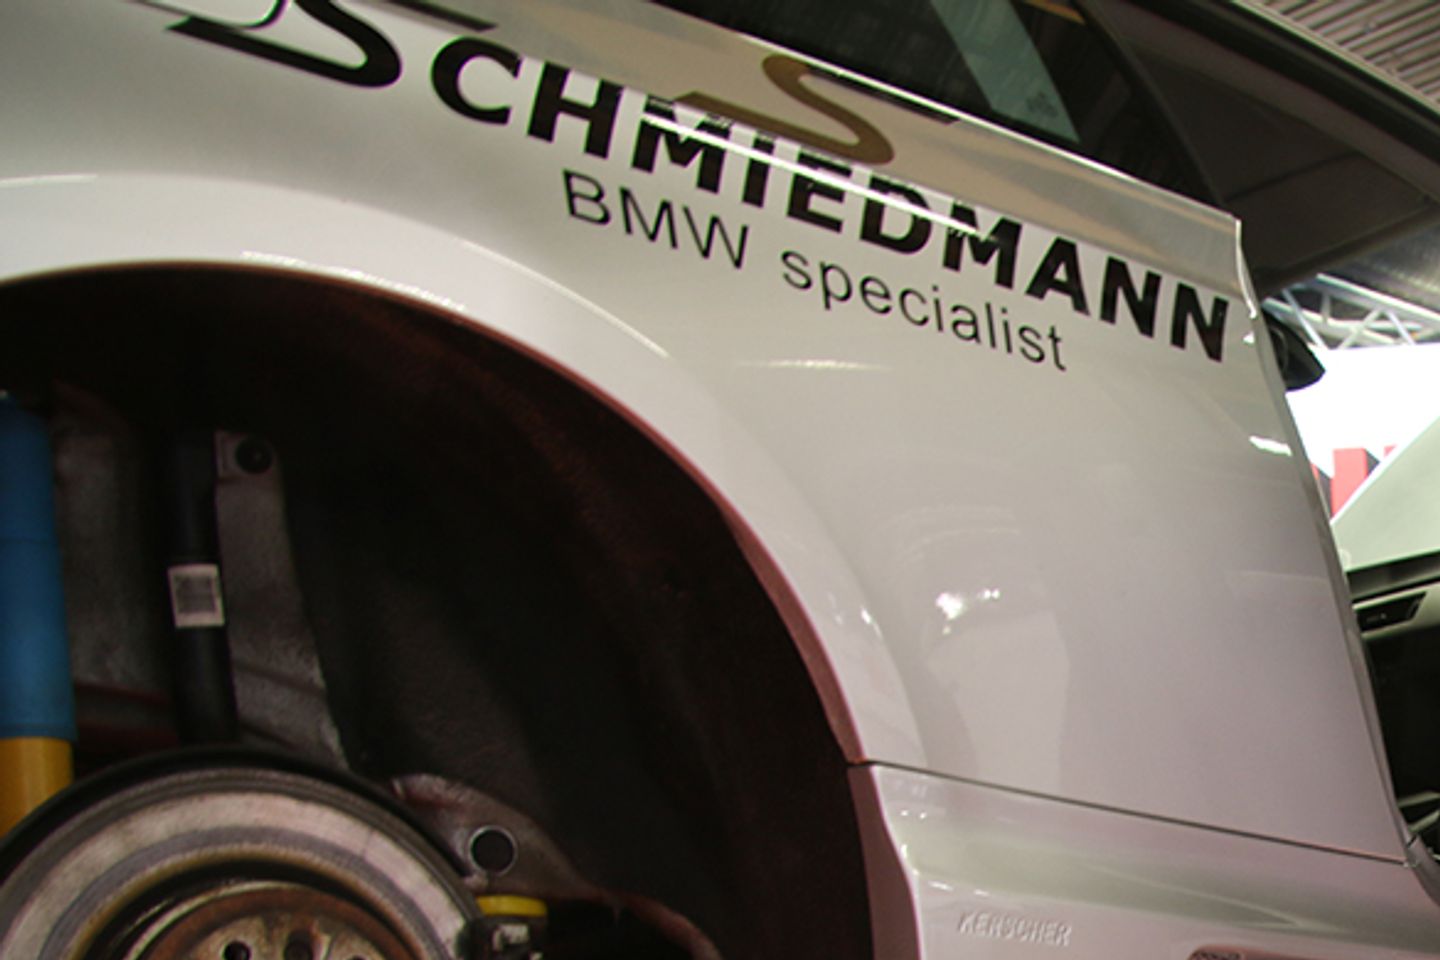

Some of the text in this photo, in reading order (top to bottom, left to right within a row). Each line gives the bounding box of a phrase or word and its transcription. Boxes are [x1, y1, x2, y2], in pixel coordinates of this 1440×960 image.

[165, 0, 1230, 362] SCHMIEDMANN
[563, 169, 1067, 371] BMW specialist
